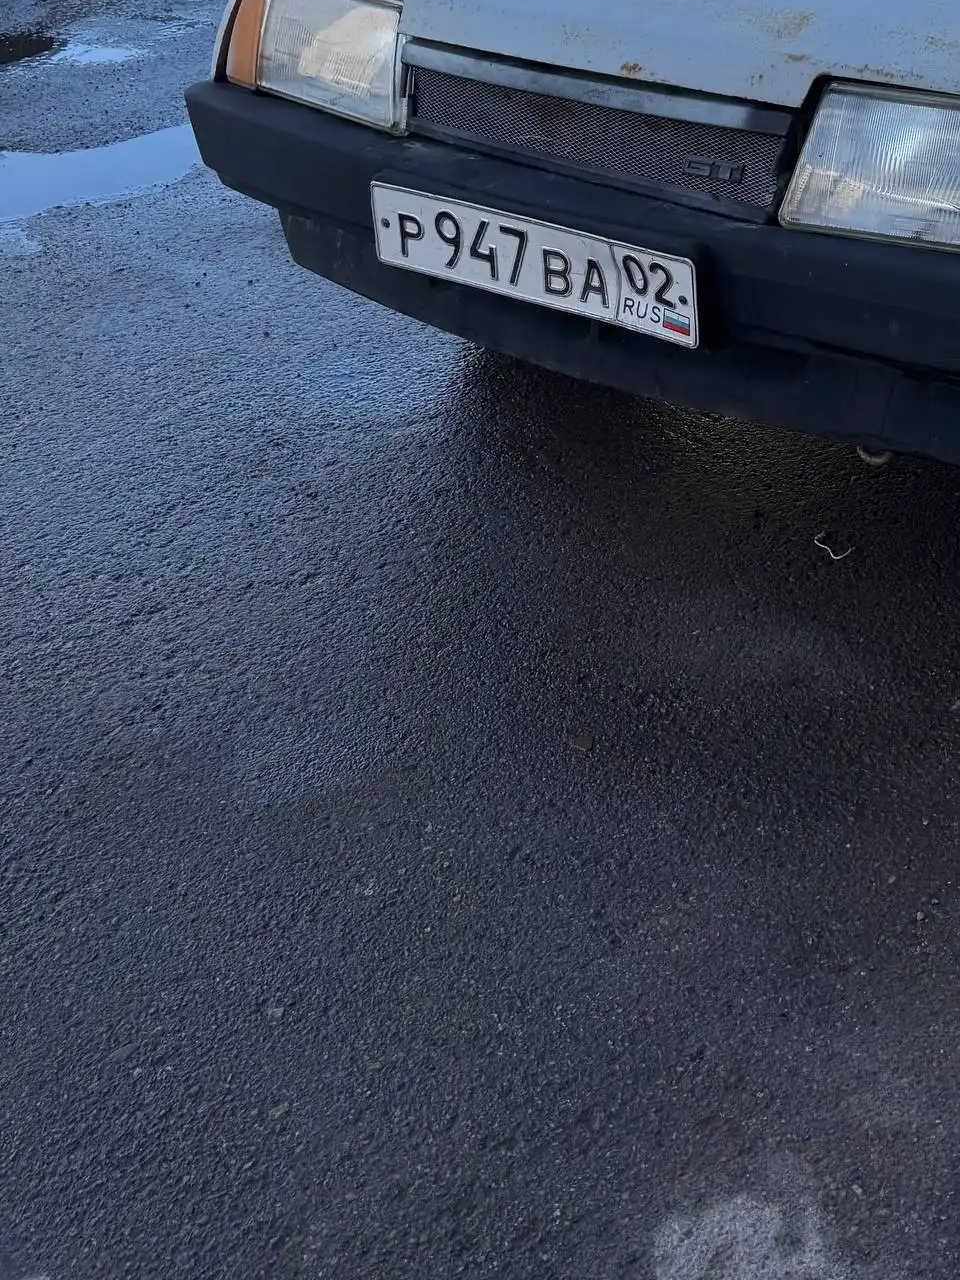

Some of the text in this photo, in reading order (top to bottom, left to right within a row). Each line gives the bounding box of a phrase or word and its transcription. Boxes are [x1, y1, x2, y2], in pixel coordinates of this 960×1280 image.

[398, 210, 676, 310] Р947ВА 02
[623, 297, 661, 323] RUS
